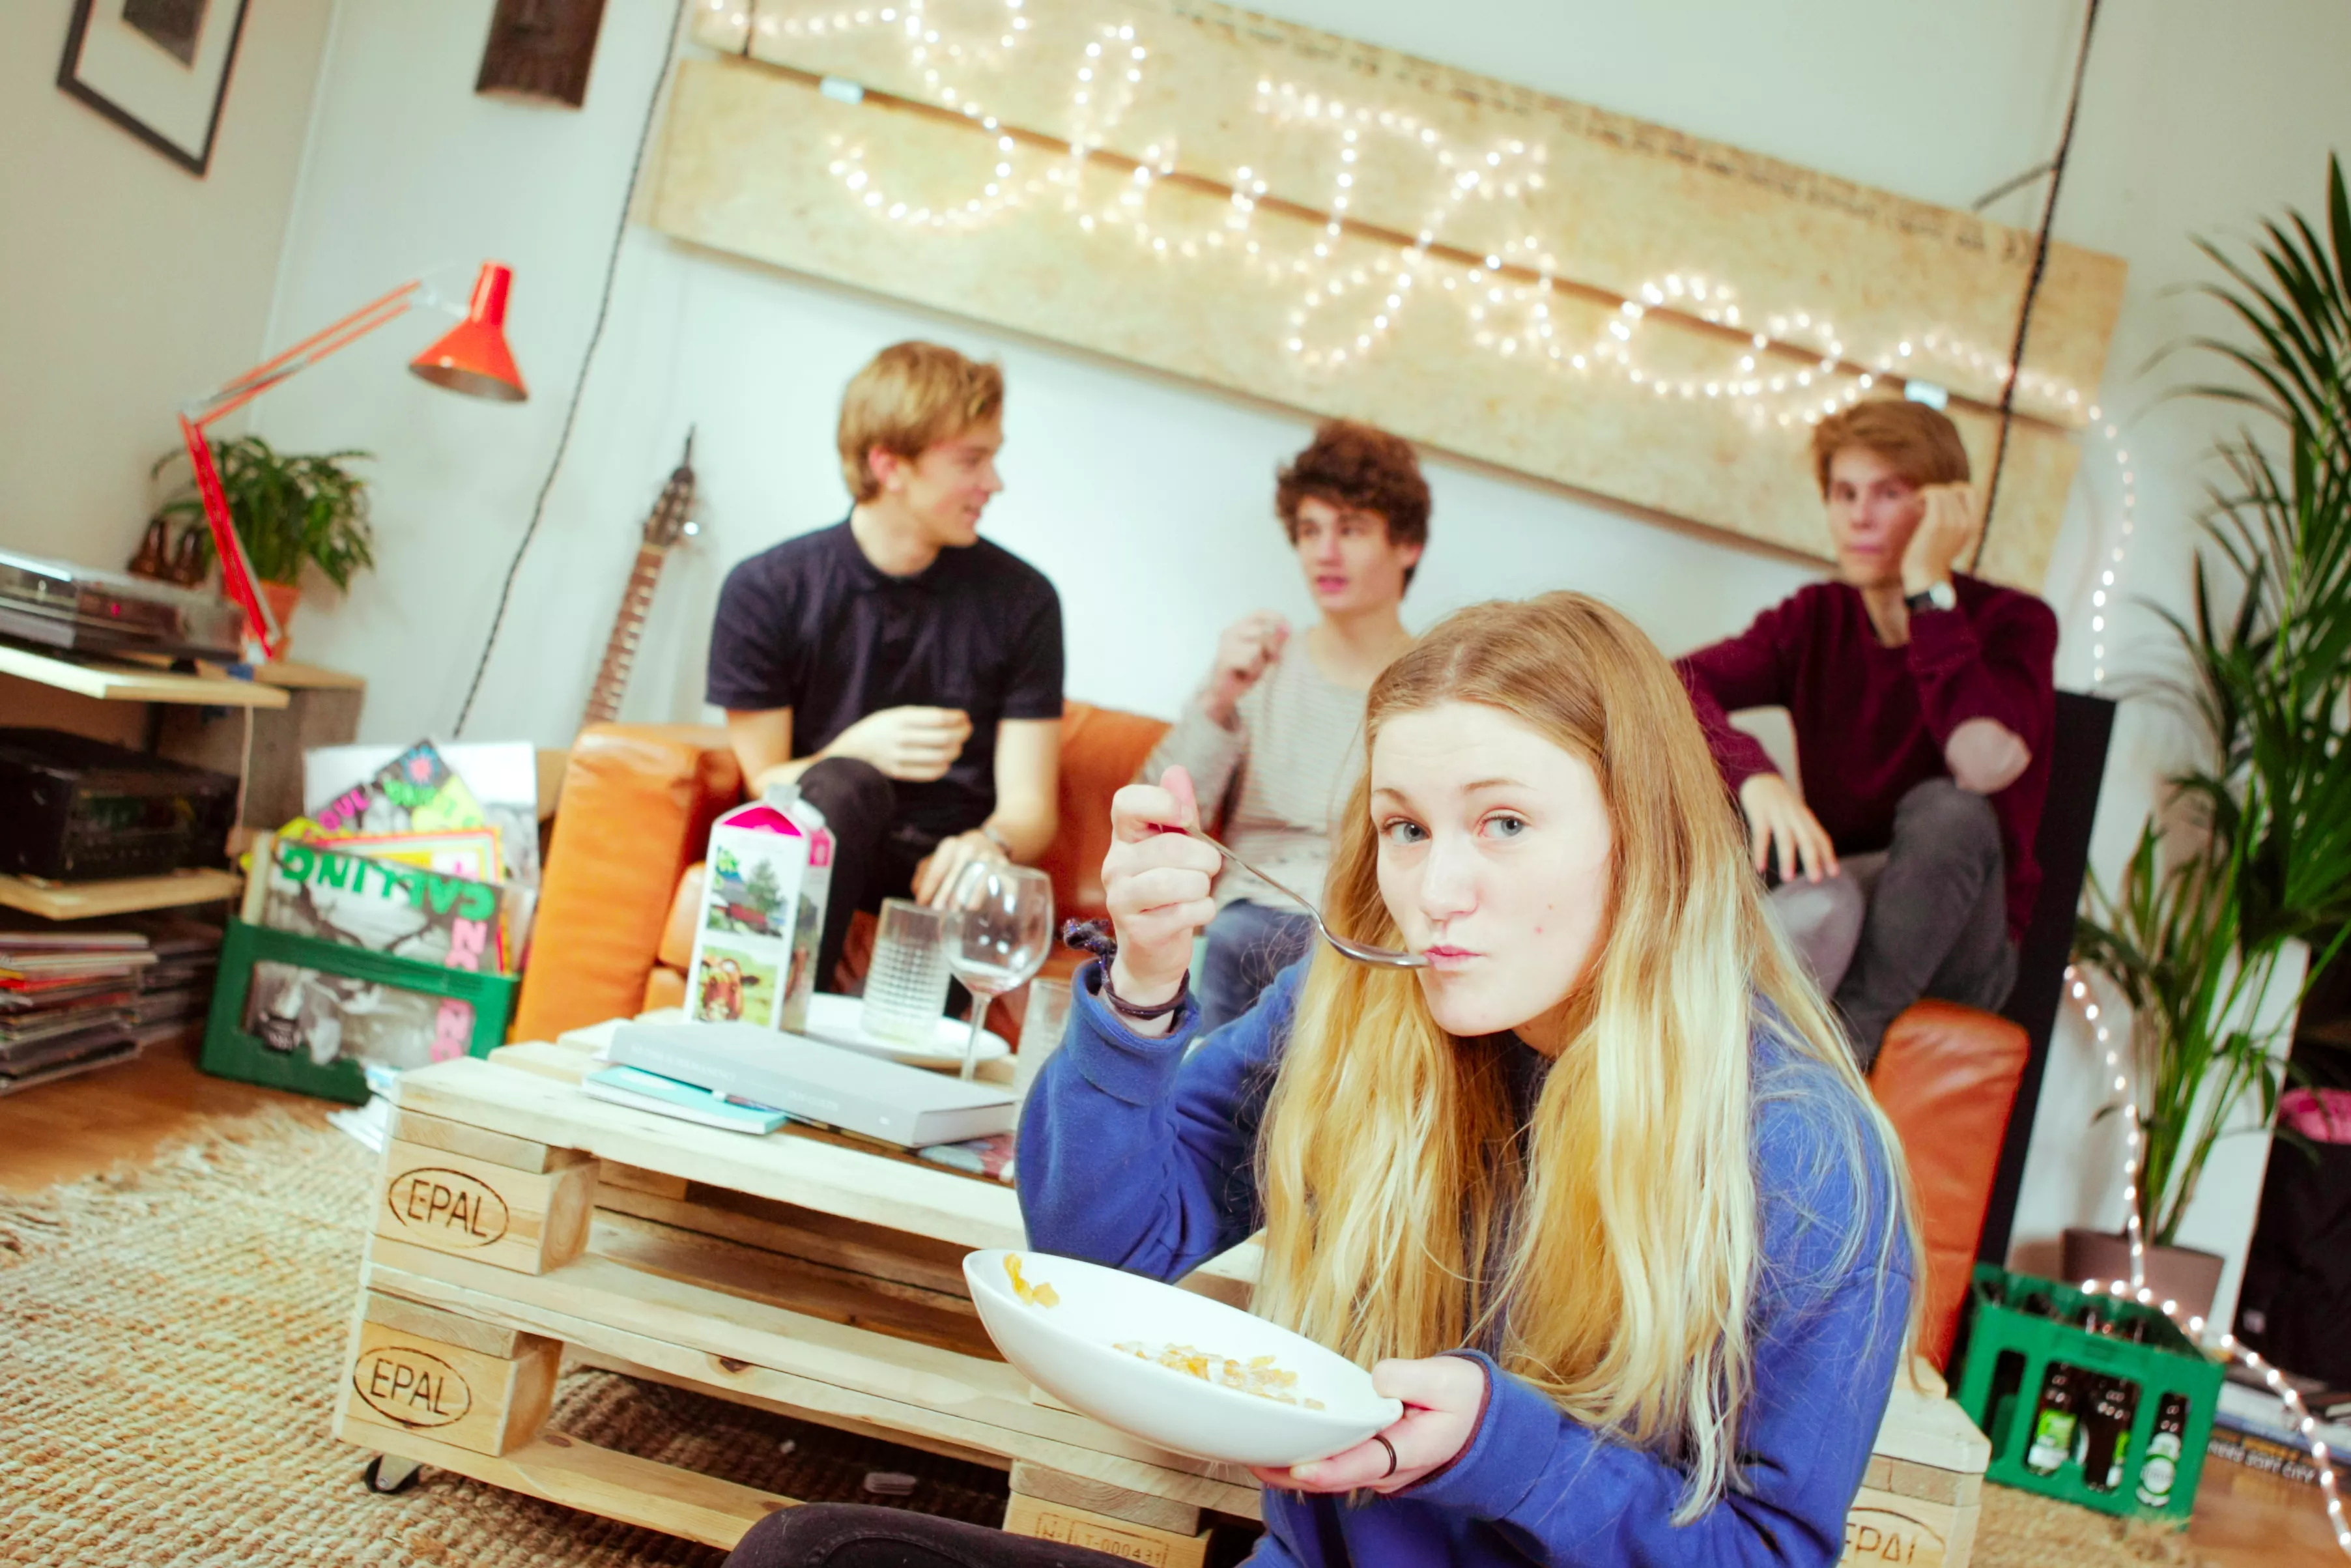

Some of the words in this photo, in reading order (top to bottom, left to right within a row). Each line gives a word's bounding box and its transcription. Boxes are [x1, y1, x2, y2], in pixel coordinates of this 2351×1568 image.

[282, 848, 495, 920] CALLING
[407, 1179, 488, 1238] EPAL
[369, 1358, 449, 1416] EPAL
